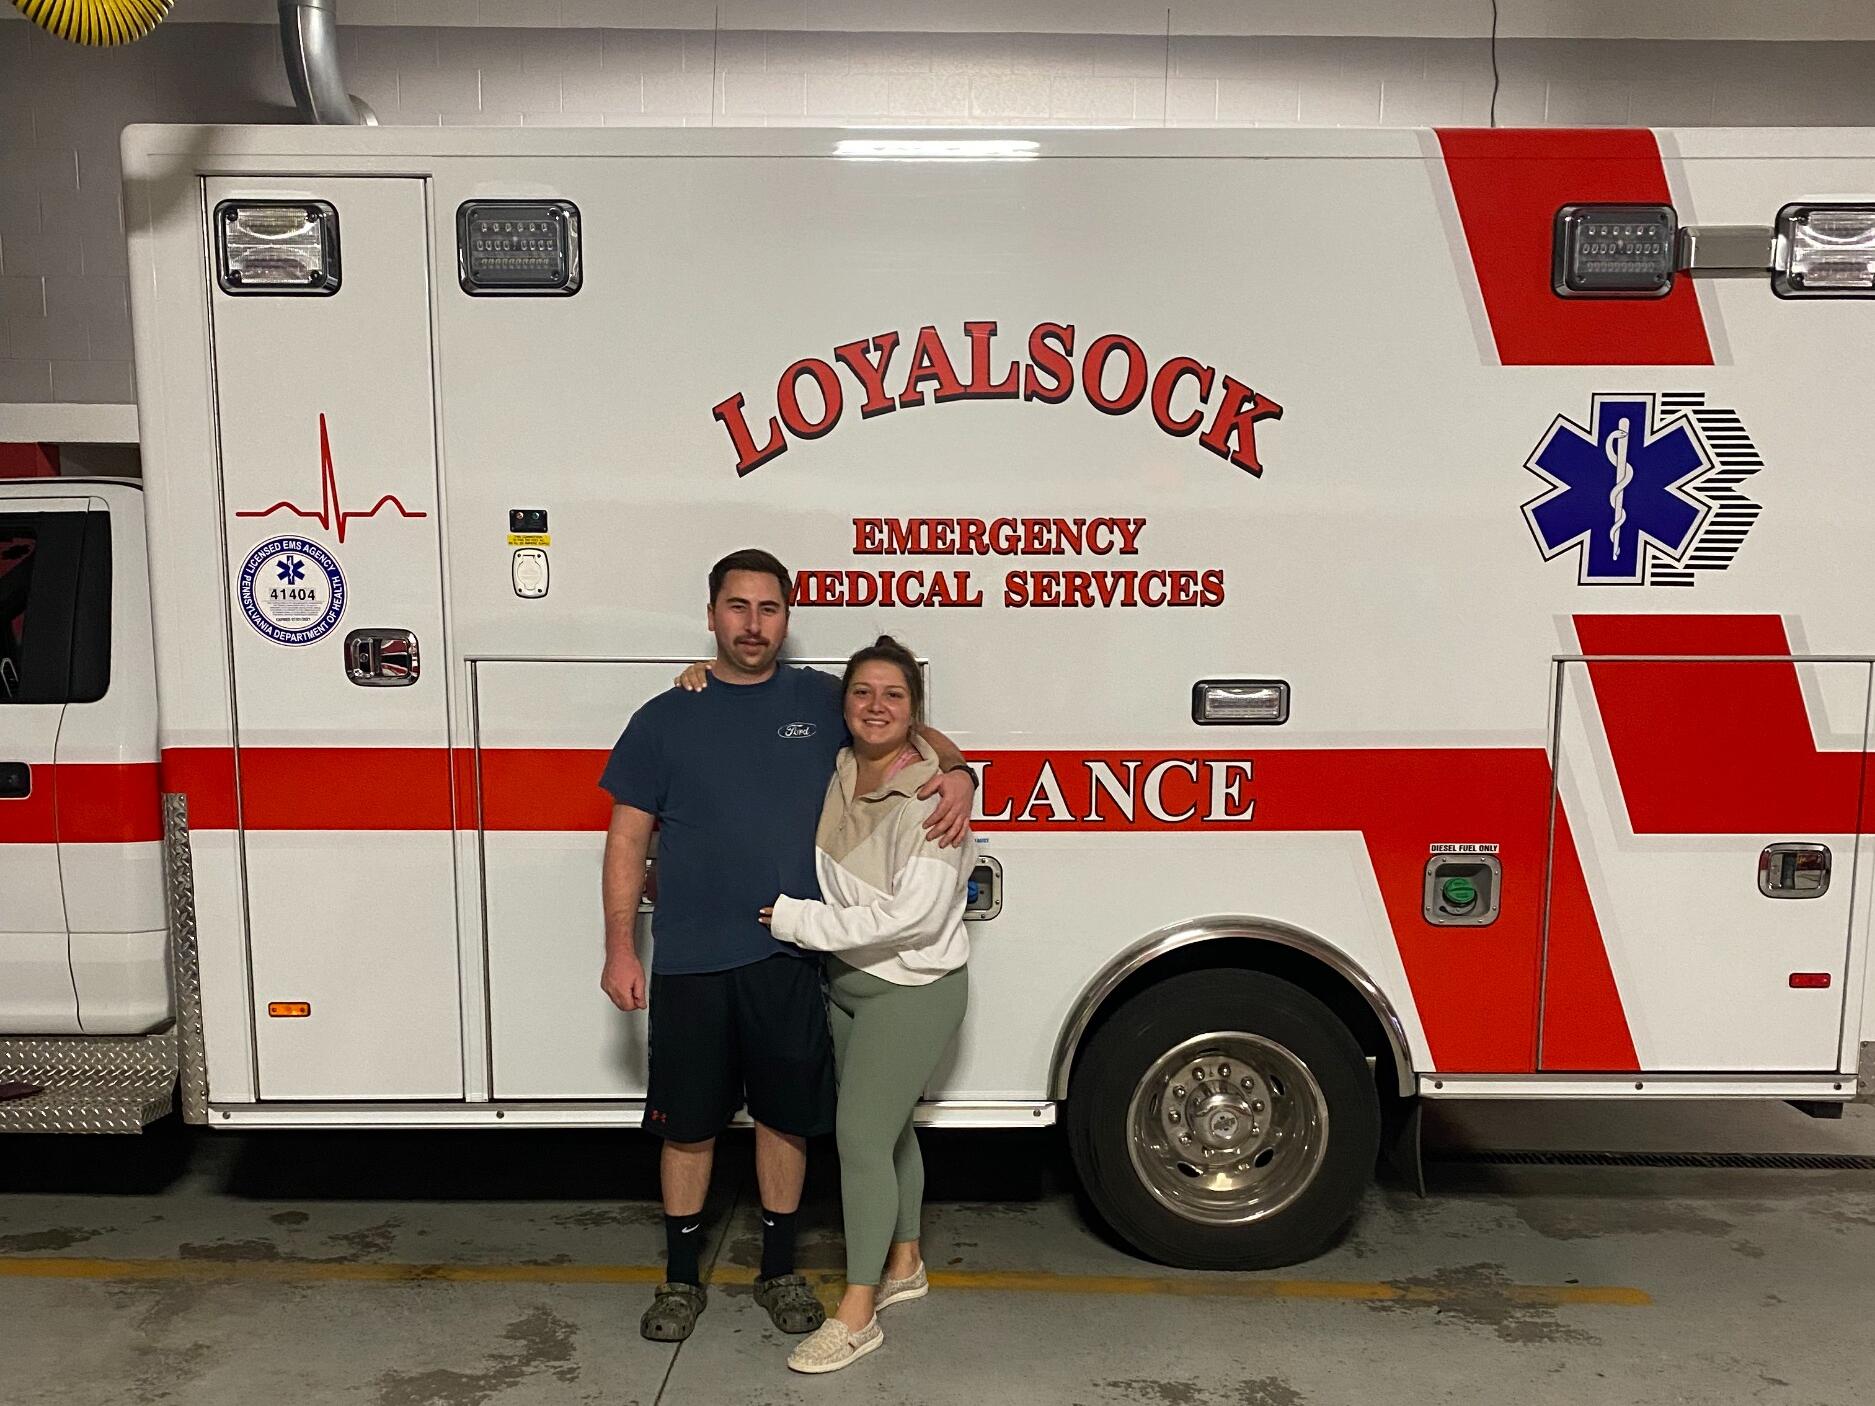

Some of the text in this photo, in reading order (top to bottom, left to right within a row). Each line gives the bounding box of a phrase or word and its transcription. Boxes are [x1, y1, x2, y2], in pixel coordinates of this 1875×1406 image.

[712, 320, 1284, 479] LOYALSOCK
[852, 517, 1147, 555] EMERGENCY
[246, 540, 336, 574] LICENSED EMS AGENCY
[270, 588, 316, 601] 41404
[789, 569, 1226, 608] MEDICAL SERVICES
[241, 575, 272, 636] PENNSYLVANIA
[273, 622, 330, 642] DEPARTMENT
[327, 611, 337, 623] OF
[332, 576, 343, 611] HEALTH
[785, 725, 809, 736] Ford
[966, 759, 1256, 823] LANCE
